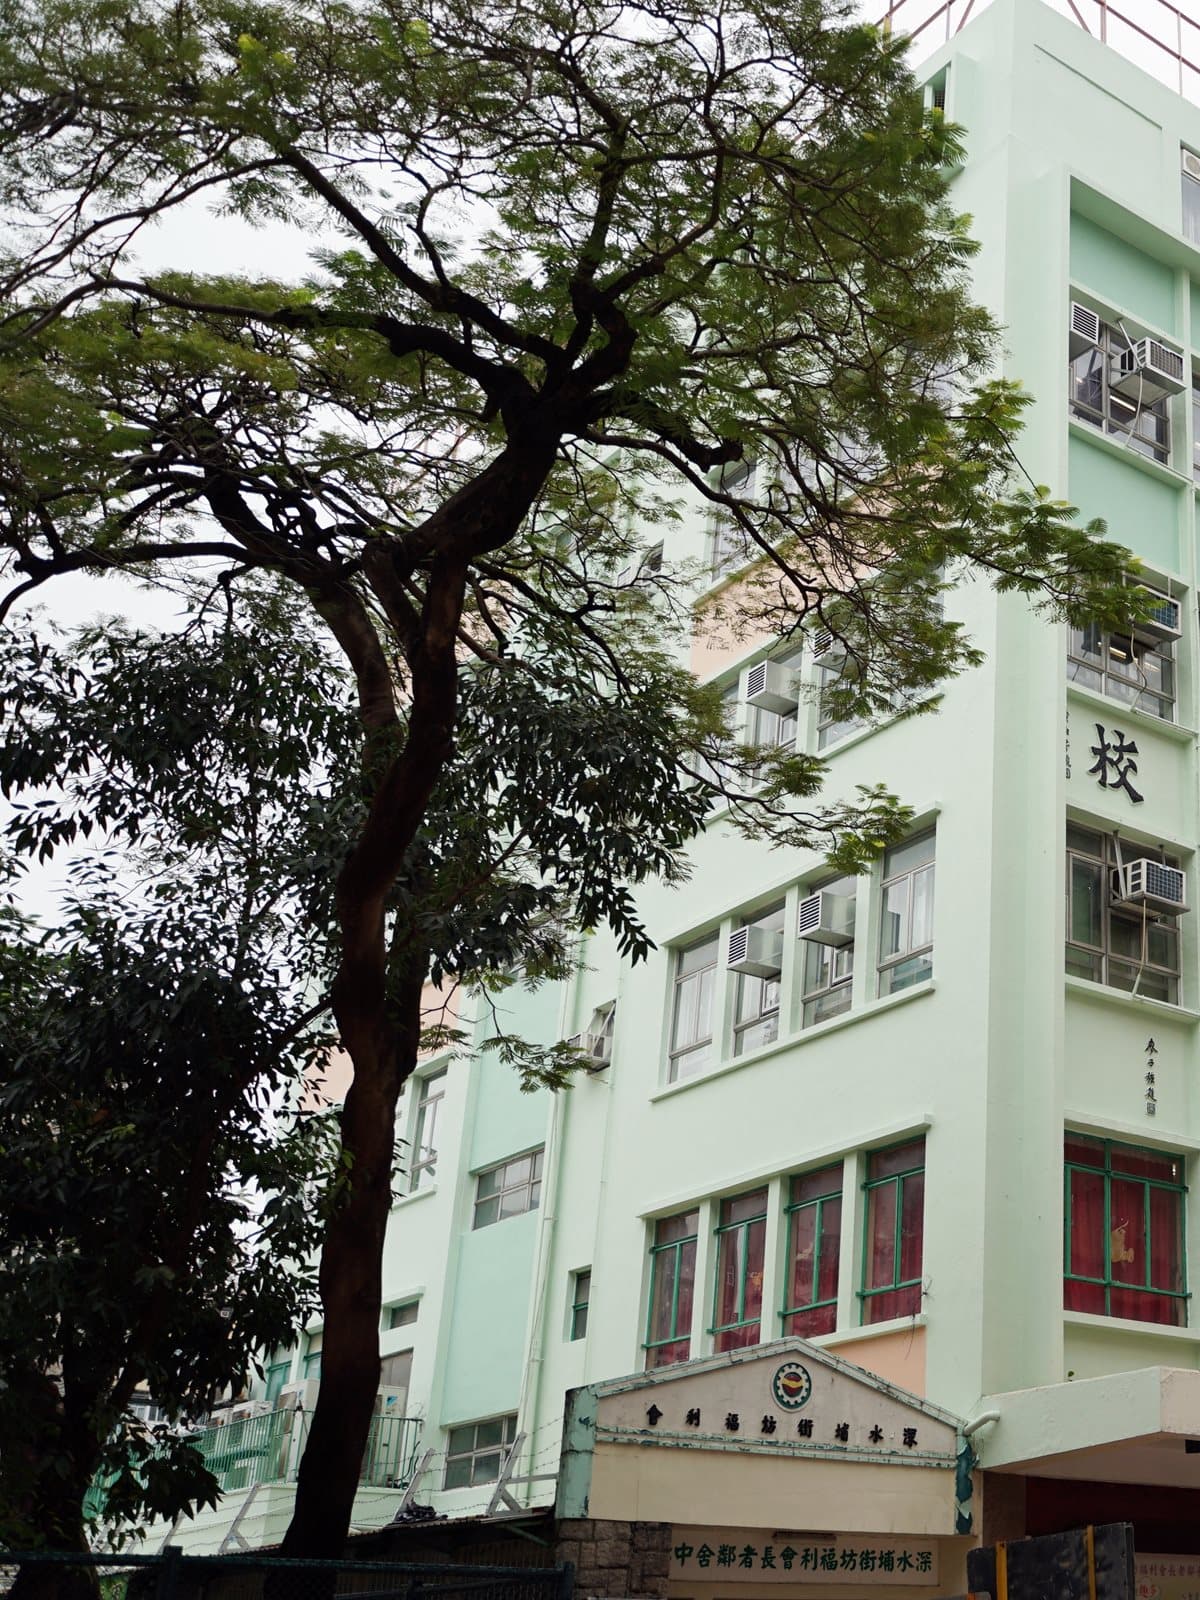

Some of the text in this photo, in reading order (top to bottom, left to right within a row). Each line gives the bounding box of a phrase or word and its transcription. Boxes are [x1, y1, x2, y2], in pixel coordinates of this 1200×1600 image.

[646, 1403, 918, 1449] 深水埔街坊福利會
[670, 1541, 932, 1573] 深水埔街坊福利會長者鄰舍中
